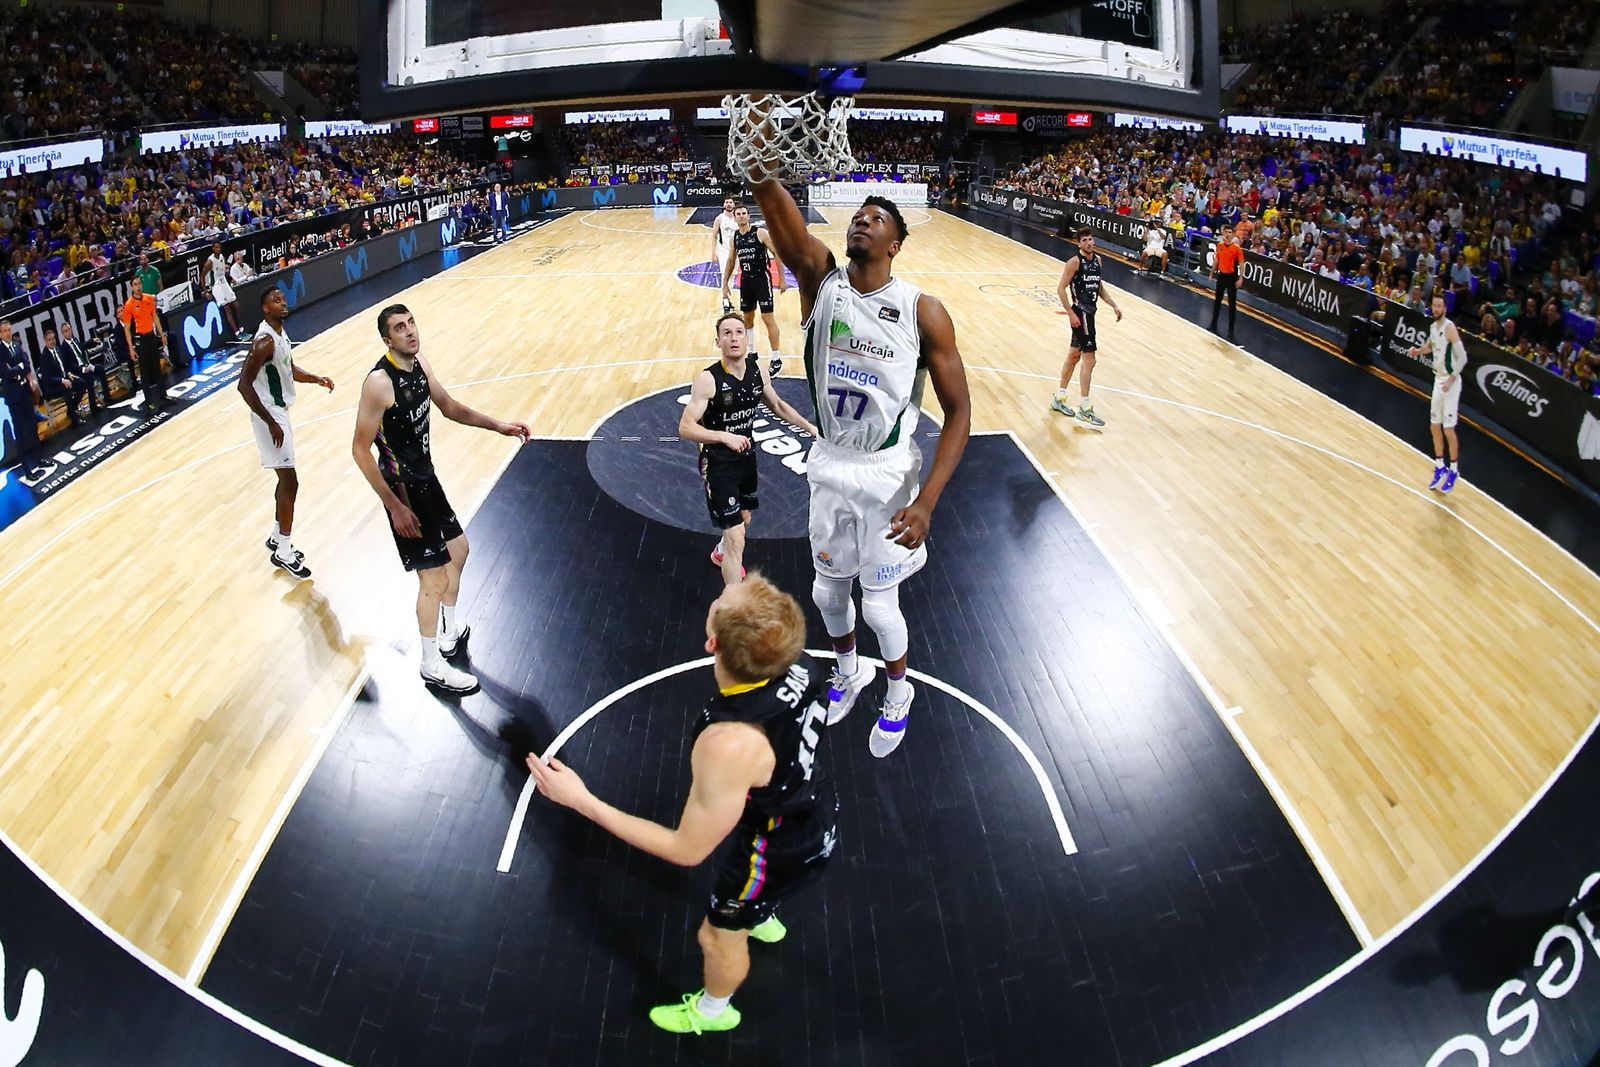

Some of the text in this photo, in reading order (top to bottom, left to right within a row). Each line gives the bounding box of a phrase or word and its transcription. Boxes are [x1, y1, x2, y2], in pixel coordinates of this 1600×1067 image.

[192, 129, 250, 143] Mutua Tinerfeña
[1269, 122, 1327, 134] Mutua Tinerfeña
[17, 150, 62, 165] Tinerfeña
[1457, 139, 1538, 163] Mutua Tinerfeña
[616, 164, 669, 174] Hisense
[686, 187, 722, 195] endesa
[1074, 211, 1124, 236] CORTEFIEL
[742, 263, 751, 271] 21
[1092, 291, 1097, 302] 3
[1281, 275, 1340, 316] NIVARIA
[849, 338, 895, 359] Unicaja
[1491, 372, 1550, 418] Balmes
[827, 388, 869, 421] 77
[41, 410, 170, 494] siente nuestra energía
